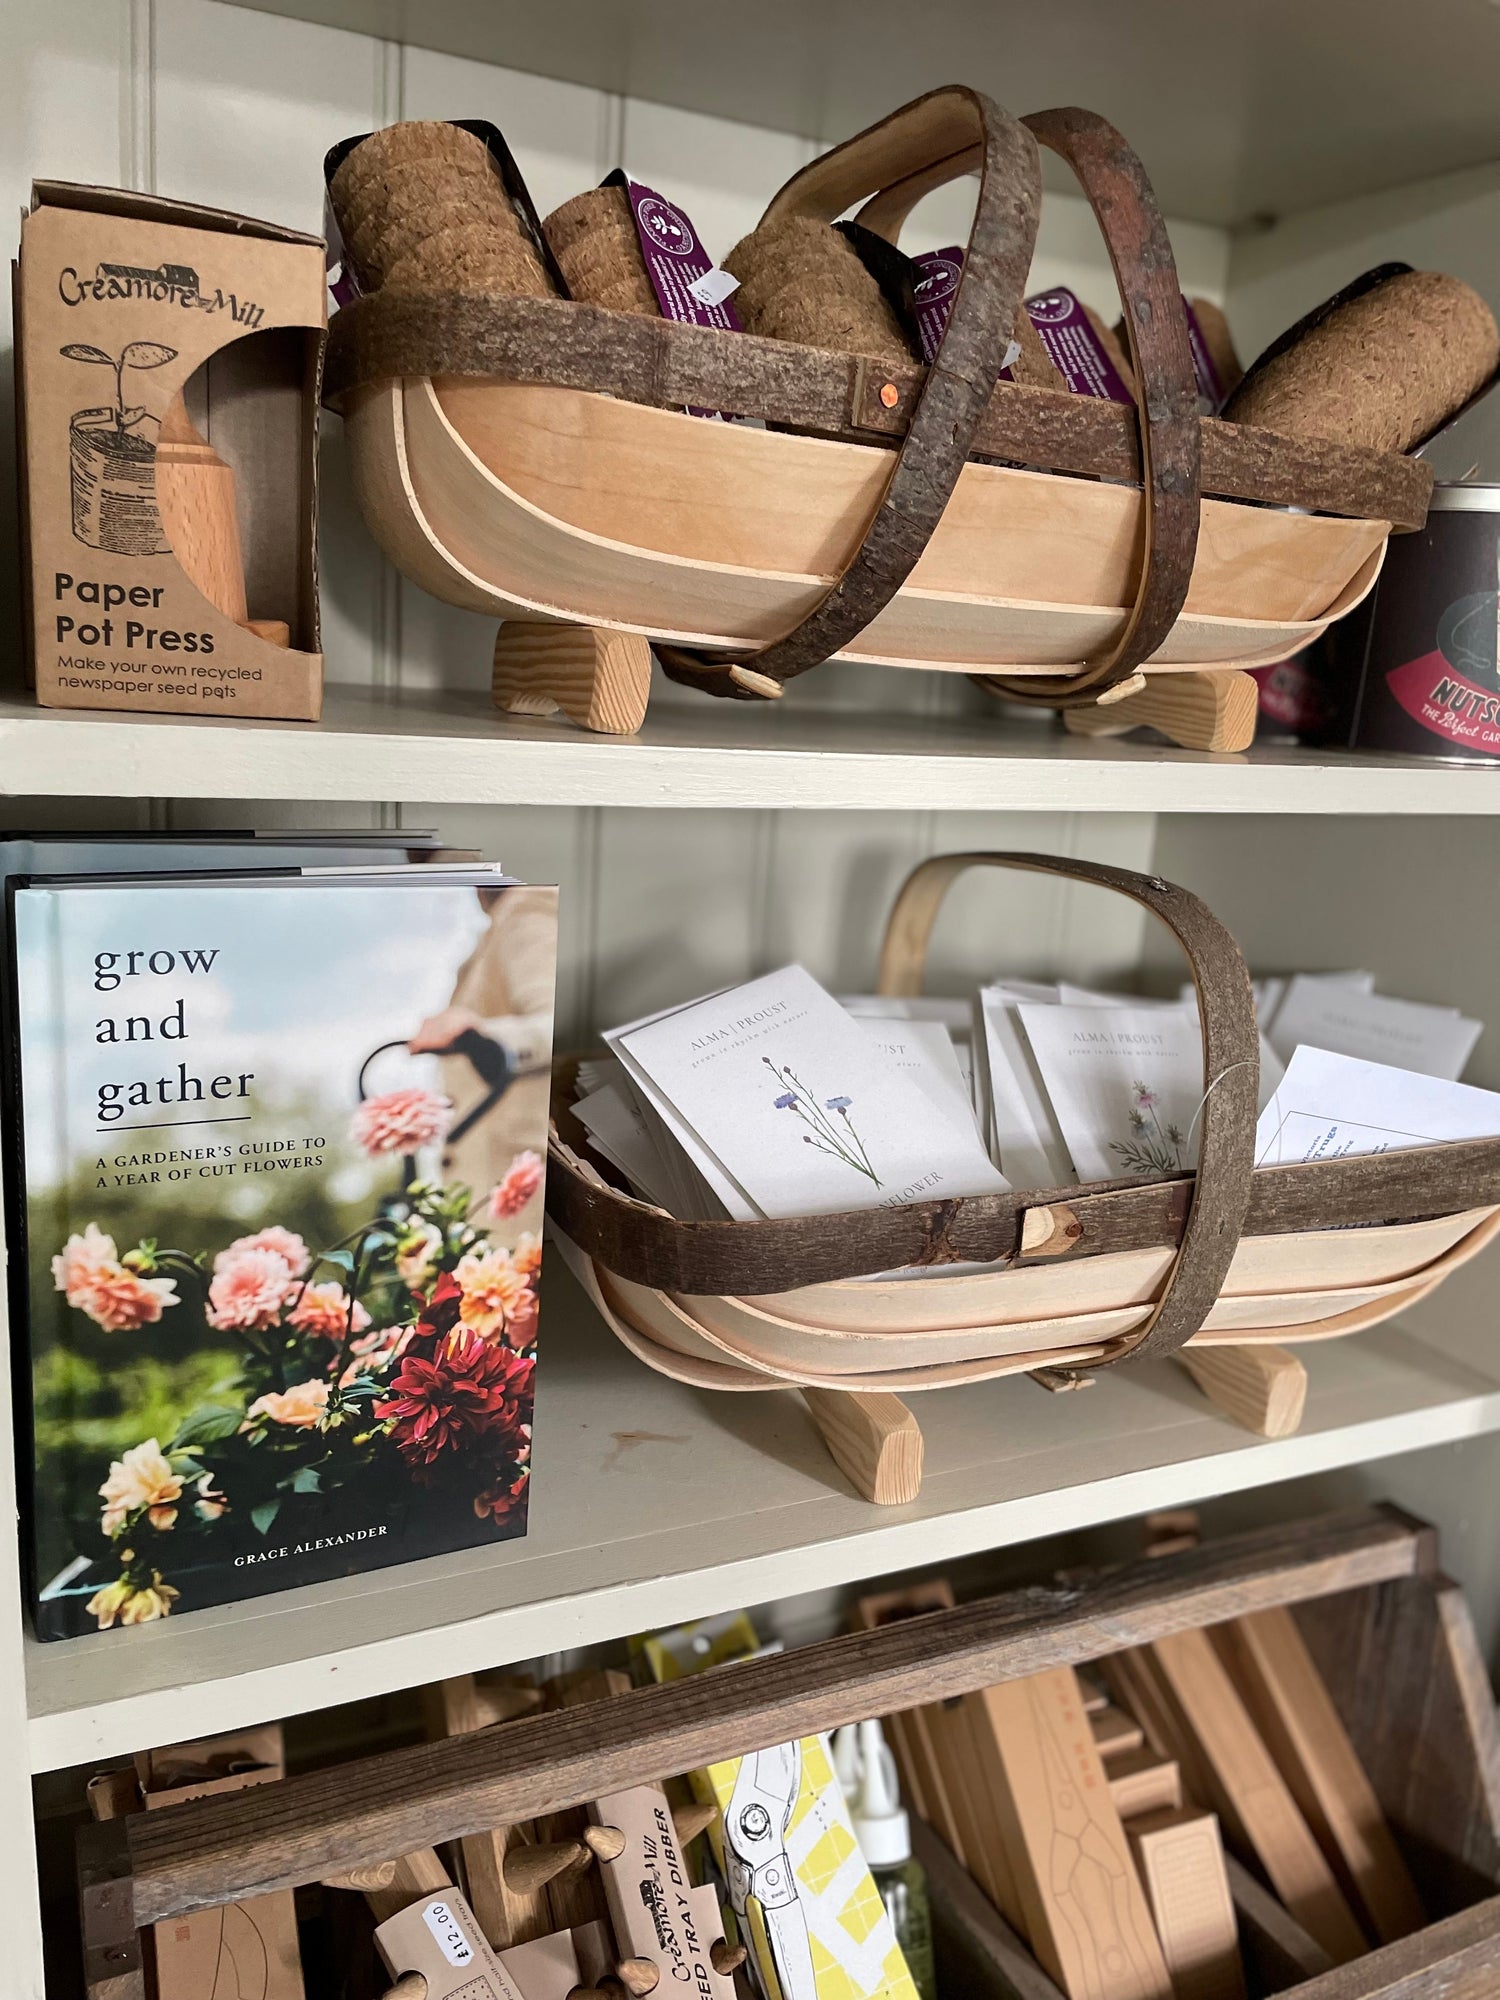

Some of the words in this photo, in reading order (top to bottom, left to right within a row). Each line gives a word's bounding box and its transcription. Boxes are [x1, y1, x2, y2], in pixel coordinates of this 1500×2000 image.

[59, 267, 196, 308] Creamore
[207, 288, 265, 328] Mill
[55, 573, 164, 611] Paper
[57, 615, 113, 646] Pot
[126, 621, 215, 653] Press
[58, 655, 105, 671] Make
[110, 660, 147, 674] your
[152, 664, 187, 676] own
[192, 666, 262, 681] recycled
[58, 676, 153, 692] newspaper
[158, 682, 197, 695] seed
[202, 684, 236, 699] pots
[1421, 704, 1441, 721] THE
[94, 949, 220, 991] grow
[96, 999, 189, 1043] and
[690, 1029, 730, 1051] ALMA
[736, 1001, 788, 1030] PROUST
[98, 1063, 254, 1122] gather
[96, 1158, 107, 1169] A
[239, 1140, 296, 1155] GUIDE
[303, 1137, 326, 1149] TO
[96, 1177, 107, 1188] A
[114, 1171, 161, 1186] YEAR
[169, 1168, 192, 1181] OF
[199, 1164, 237, 1177] CUT
[244, 1155, 323, 1173] FLOWERS
[234, 1547, 288, 1567] GRACE
[294, 1525, 388, 1554] ALEXANDER
[654, 1808, 683, 1886] DIBBER
[455, 1898, 468, 1920] trays
[675, 1893, 700, 1953] TRAY
[432, 1906, 469, 1959] £12.00
[466, 1922, 482, 1946] seed
